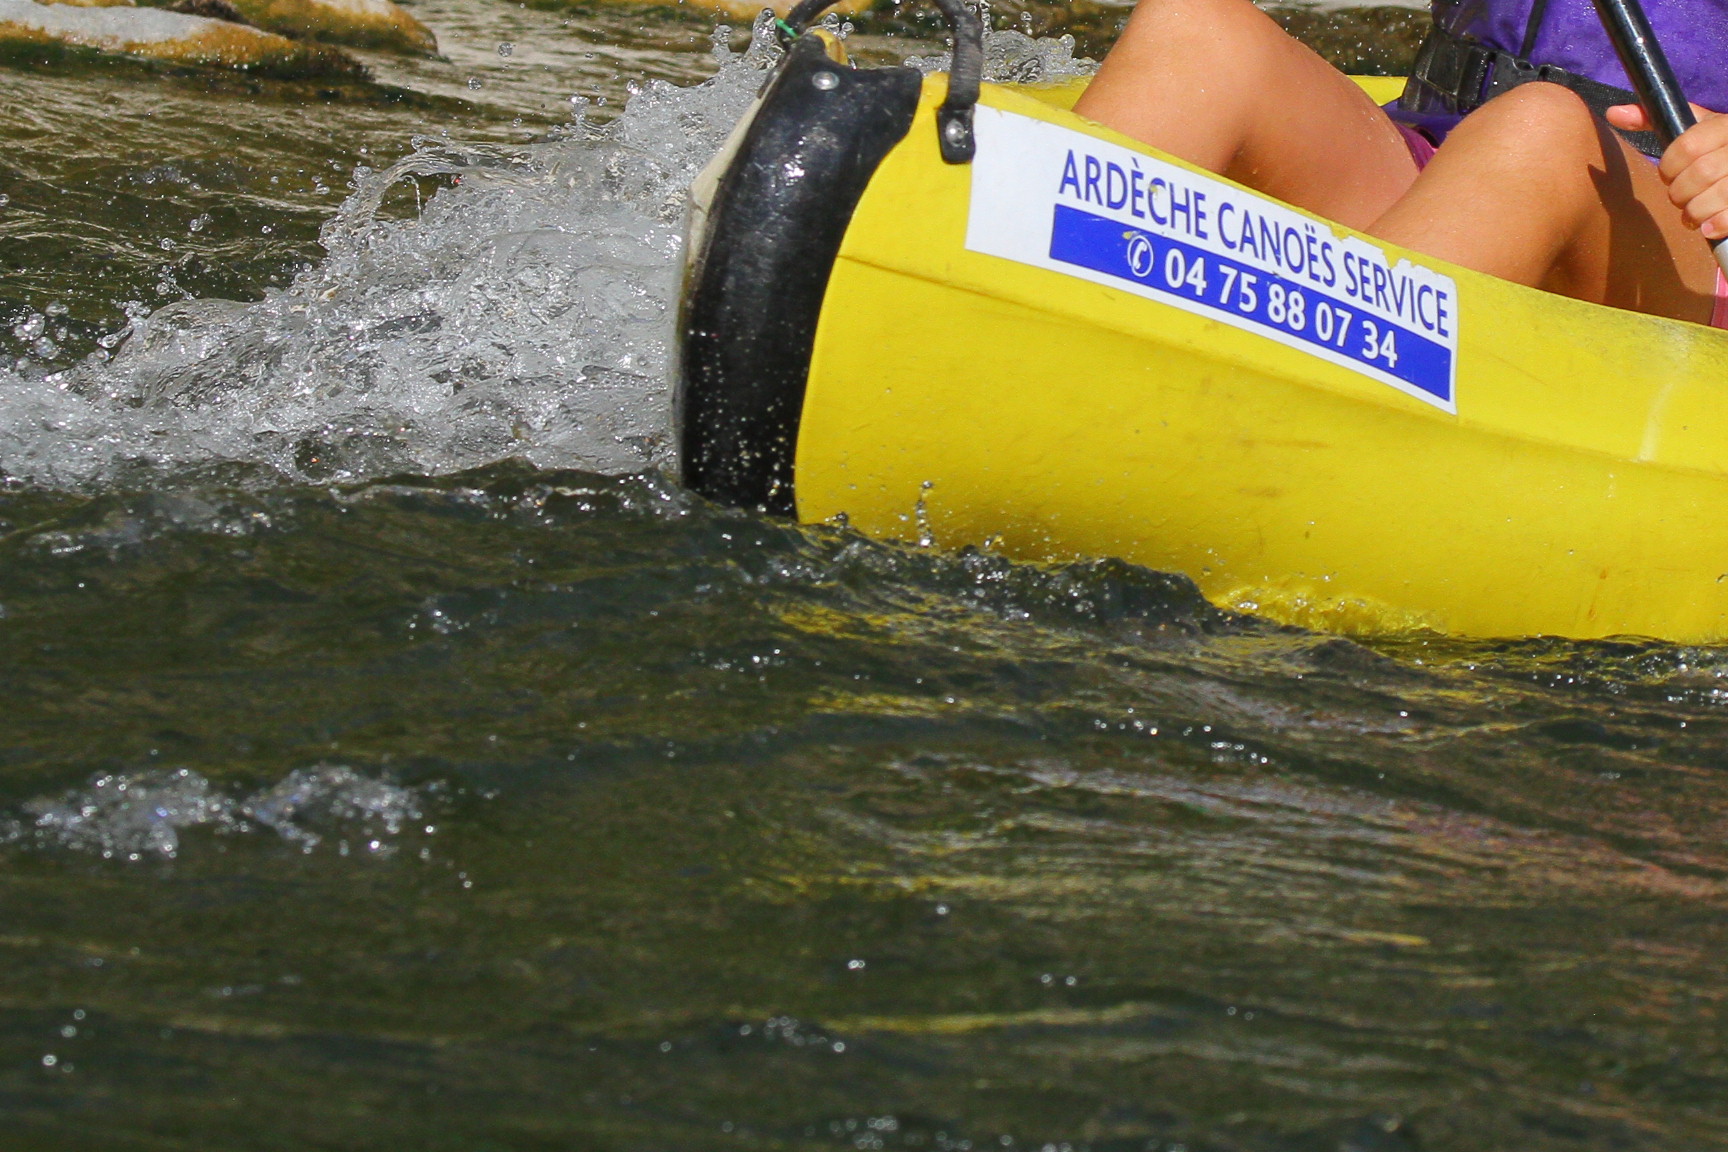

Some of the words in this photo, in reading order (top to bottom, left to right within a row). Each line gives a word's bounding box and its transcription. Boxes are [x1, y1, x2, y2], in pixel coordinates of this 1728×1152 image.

[1058, 148, 1208, 241] ARDÈCHE
[1217, 201, 1337, 288] CANOËS
[1344, 250, 1451, 339] SERVICE
[1164, 247, 1207, 298] 04
[1218, 264, 1258, 314] 75
[1267, 283, 1306, 332] 88
[1315, 307, 1353, 348] 07
[1362, 321, 1398, 369] 34
